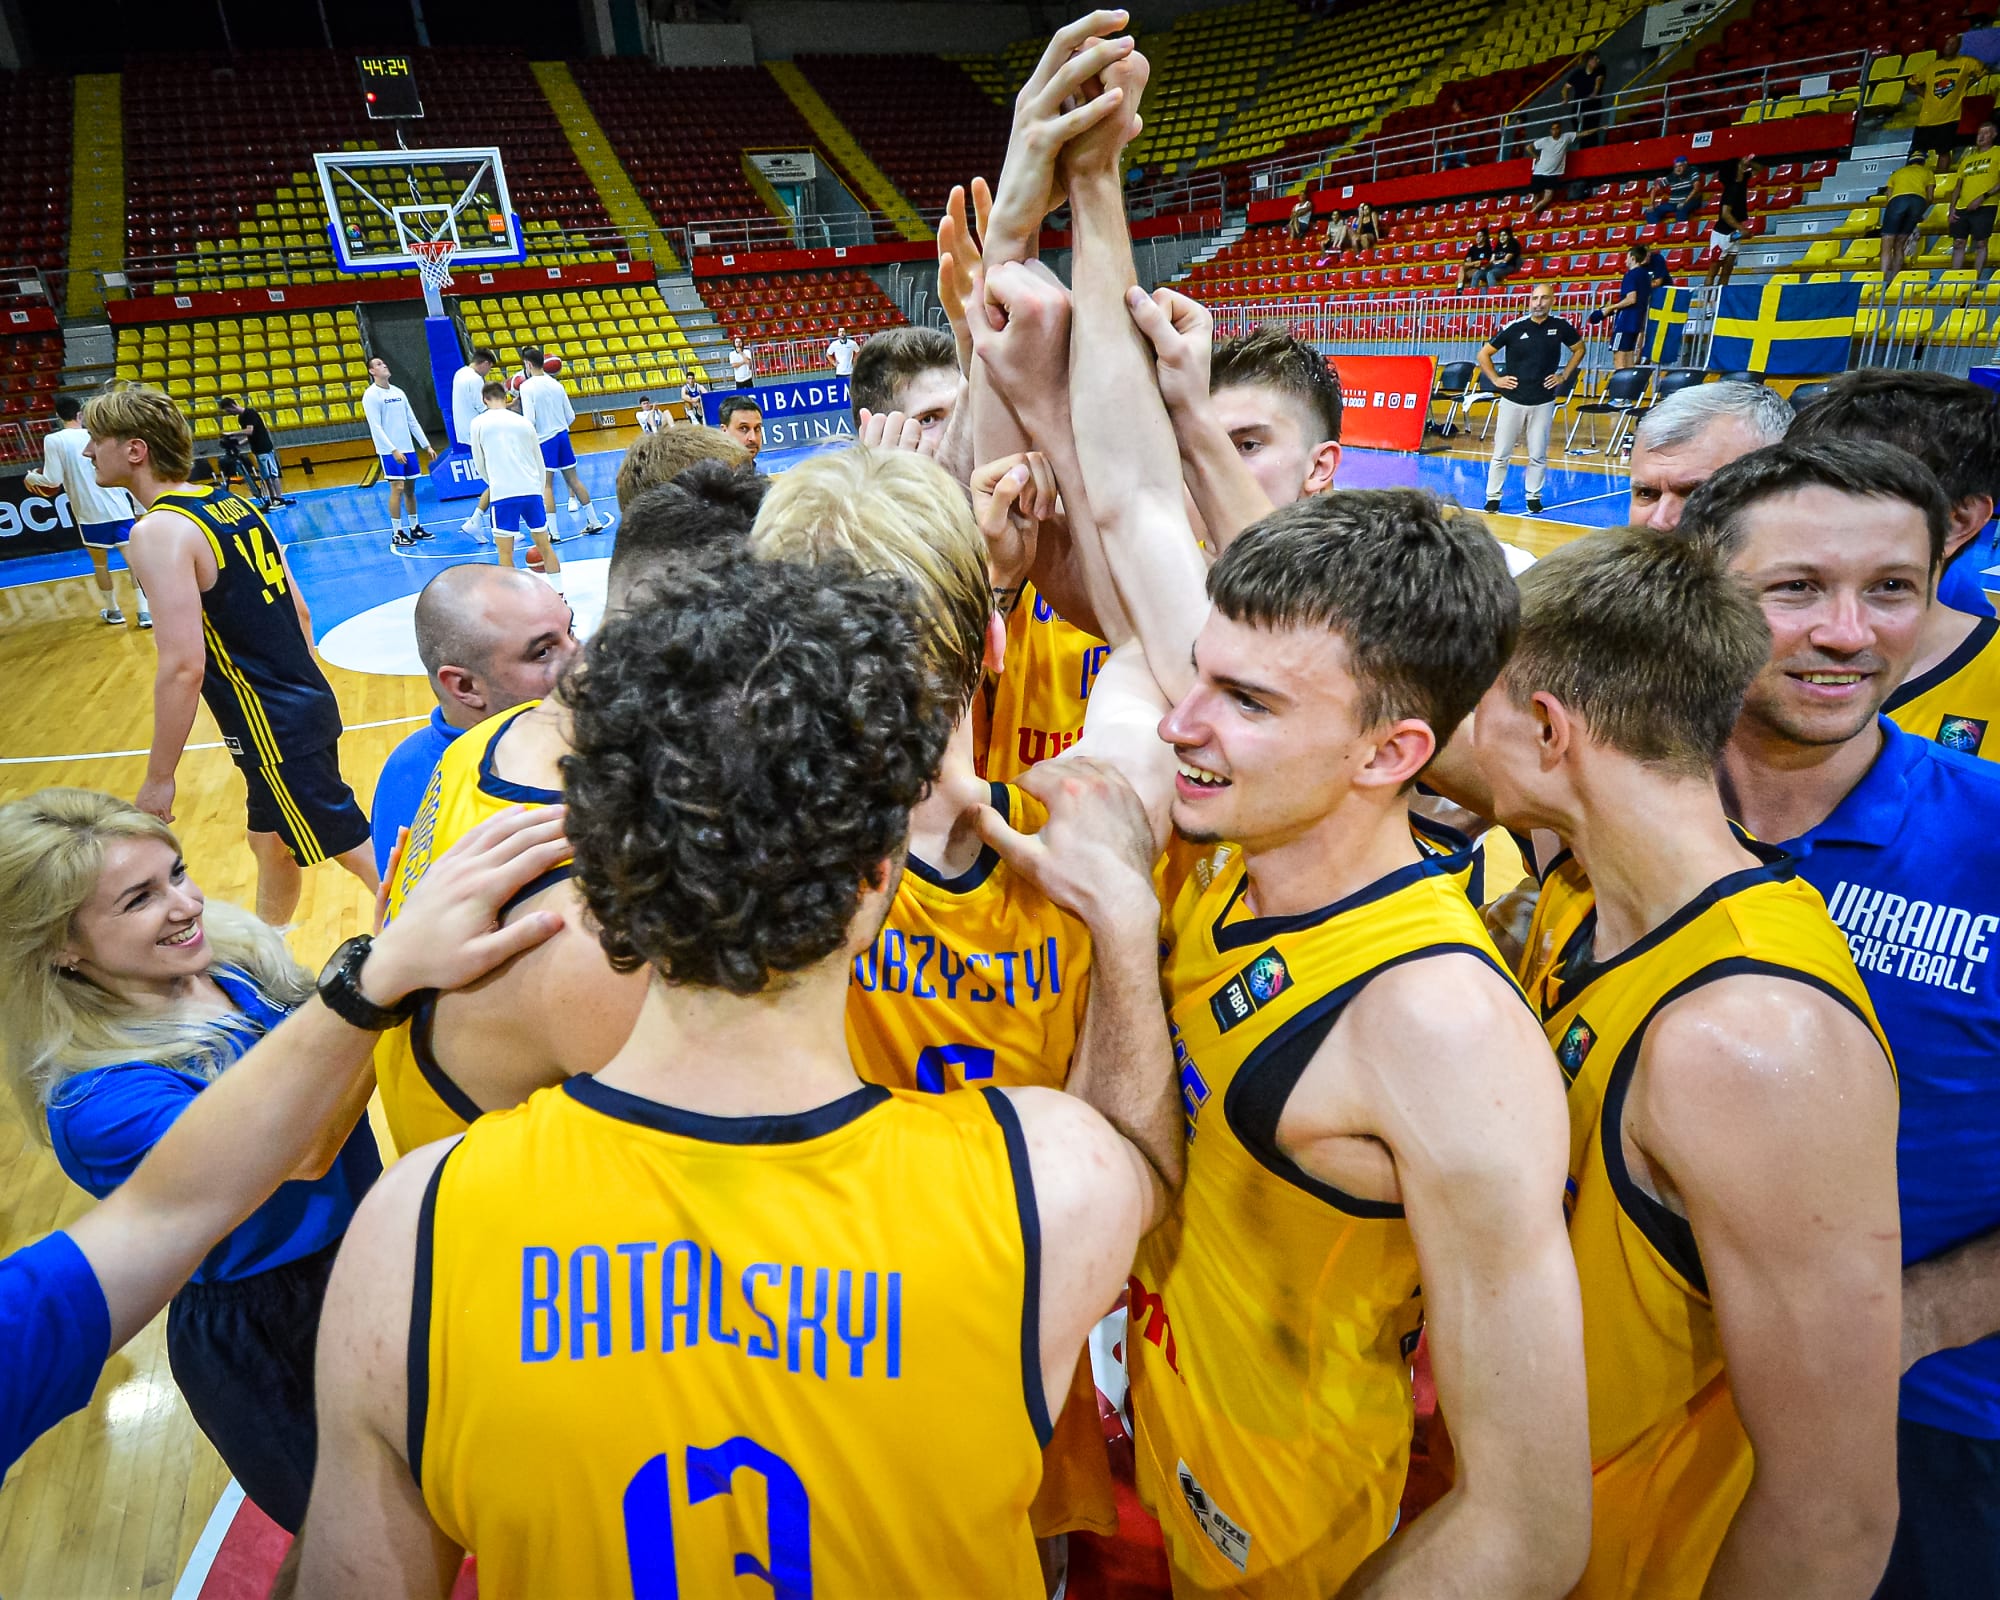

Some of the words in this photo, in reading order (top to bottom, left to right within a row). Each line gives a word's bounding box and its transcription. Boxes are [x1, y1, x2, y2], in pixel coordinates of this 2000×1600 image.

[362, 59, 408, 76] 44:24
[233, 527, 286, 605] 14
[1828, 880, 2000, 963] UKRAINE
[1841, 930, 1976, 994] SKETBALL
[1226, 982, 1250, 1019] FIBA
[520, 1239, 902, 1382] BATALSKYI
